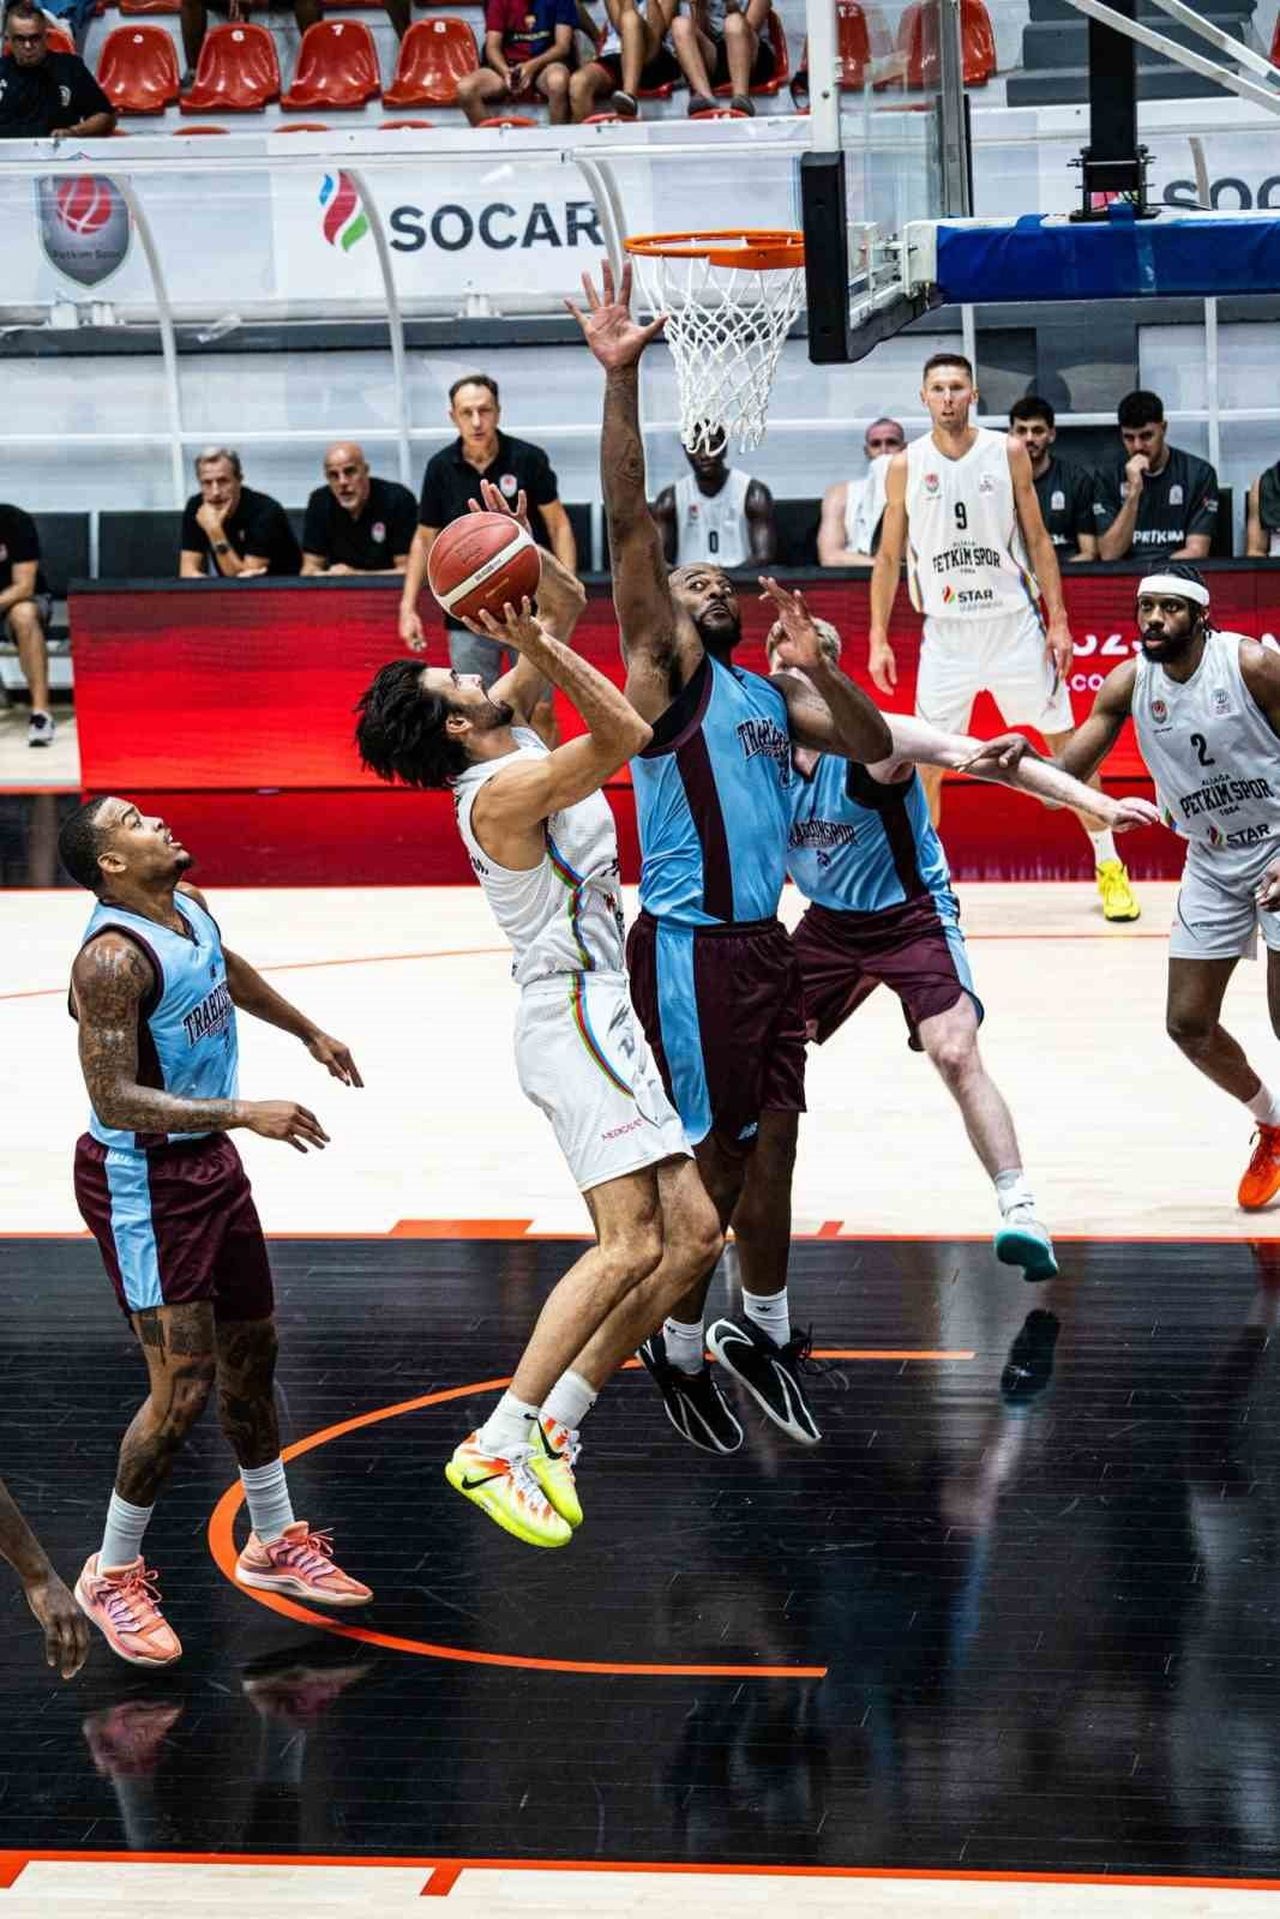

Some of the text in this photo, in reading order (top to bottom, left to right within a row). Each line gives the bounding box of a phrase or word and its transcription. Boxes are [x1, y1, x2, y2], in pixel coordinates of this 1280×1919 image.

[331, 24, 344, 36] 7
[390, 201, 606, 252] SOCAR
[954, 501, 968, 530] 9
[709, 530, 719, 554] 0
[957, 589, 994, 603] STAR
[1190, 733, 1216, 766] 2
[1226, 823, 1271, 846] STAR
